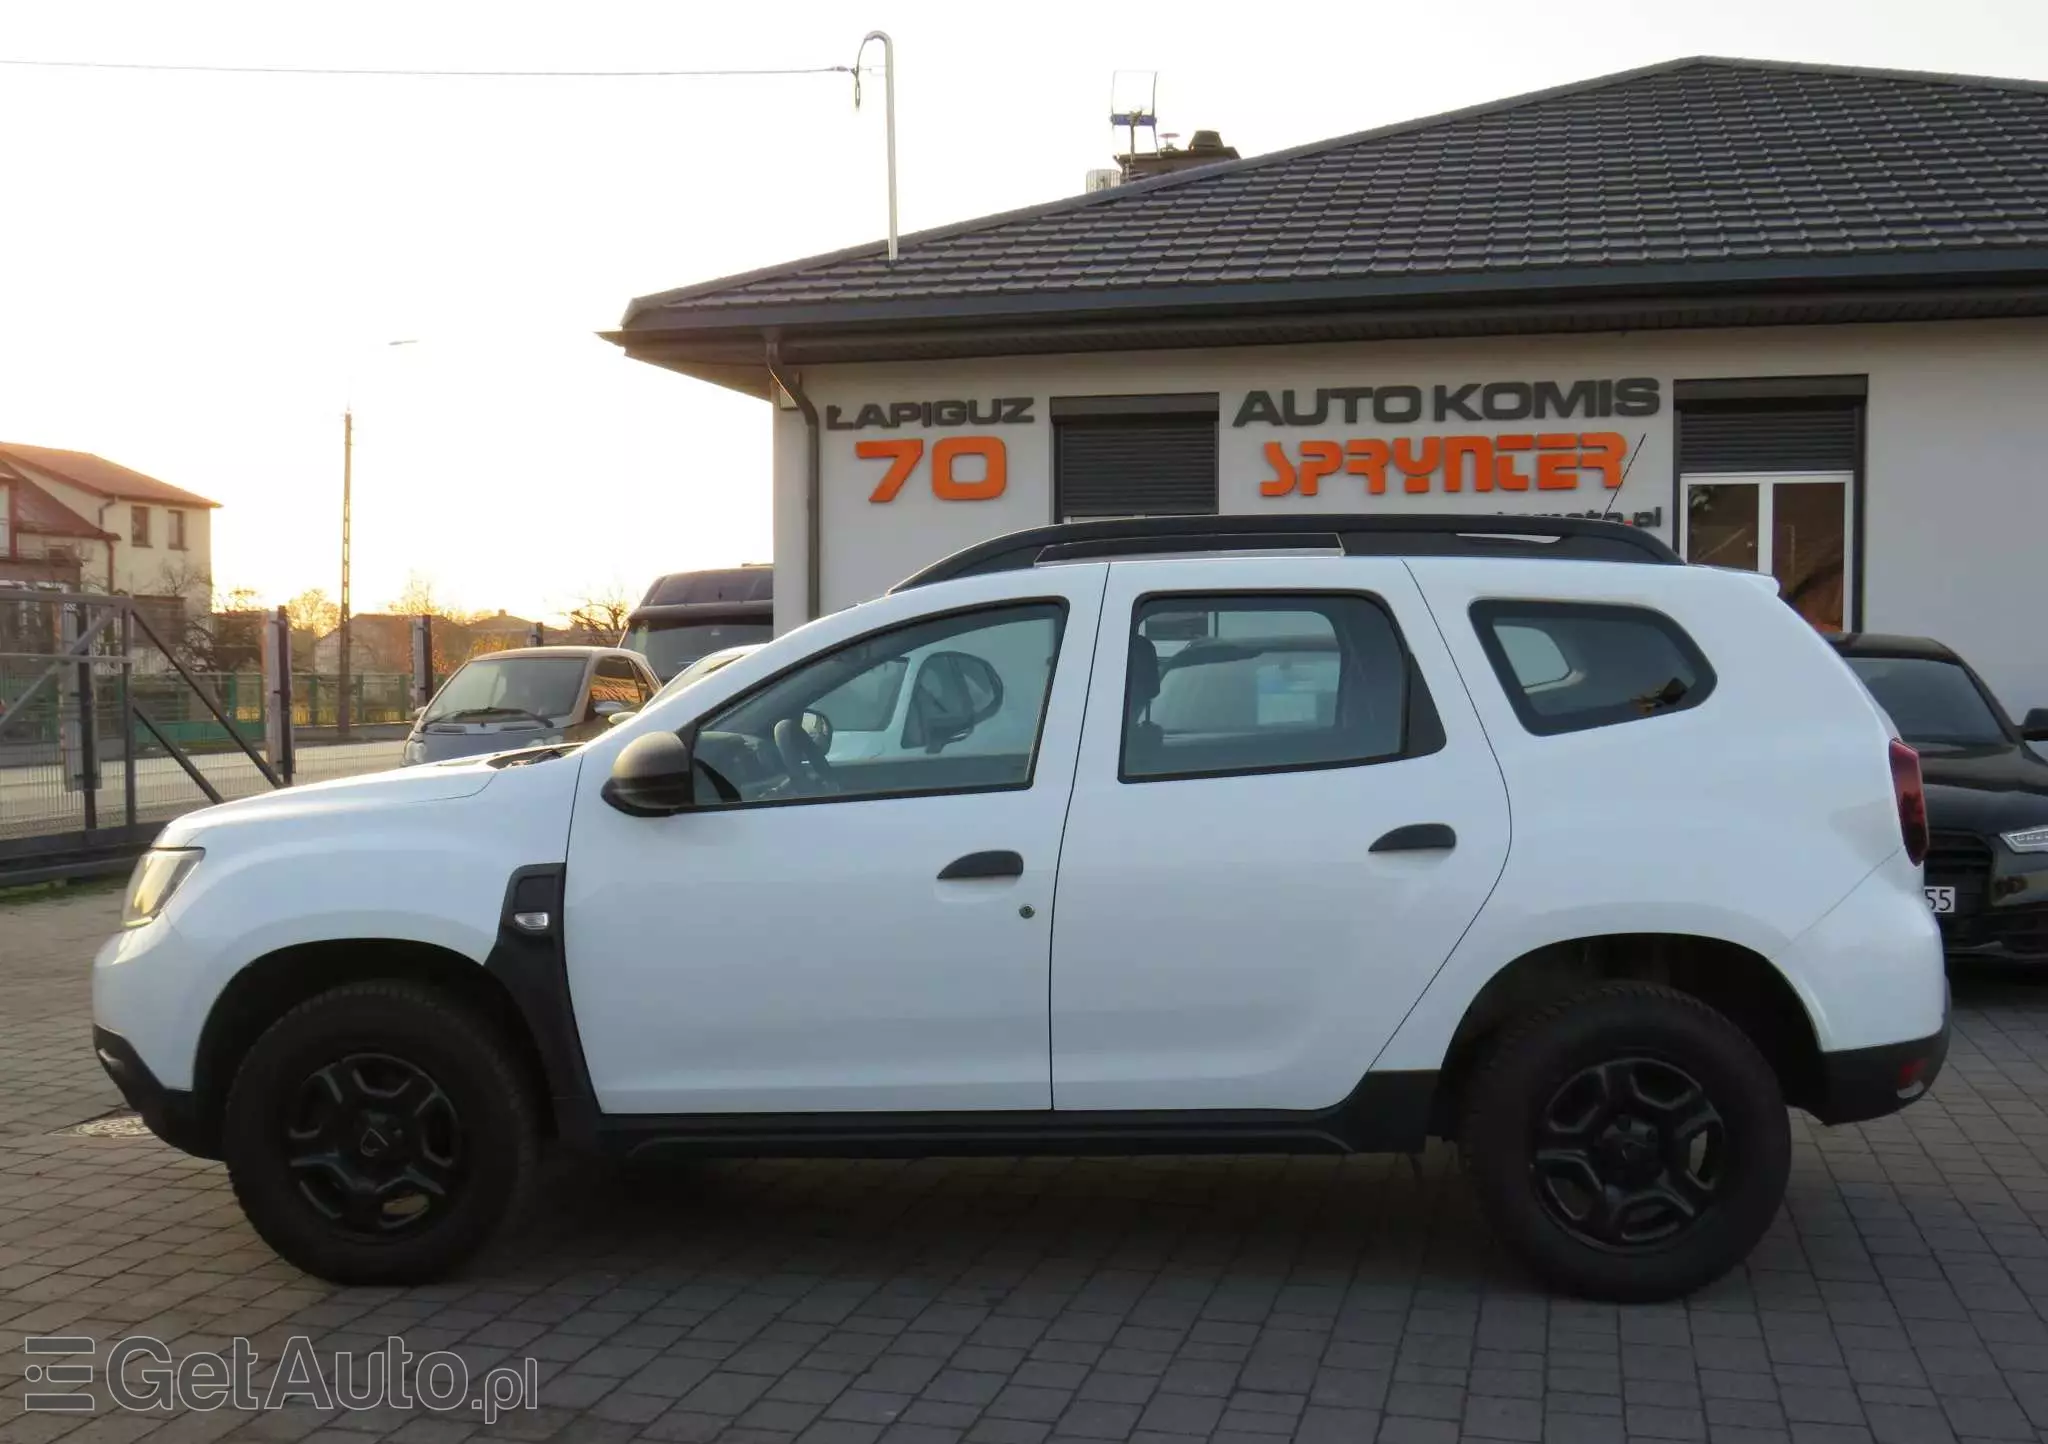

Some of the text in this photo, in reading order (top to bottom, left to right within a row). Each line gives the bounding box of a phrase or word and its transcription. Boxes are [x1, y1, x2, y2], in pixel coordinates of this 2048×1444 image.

[826, 397, 1035, 430] ŁAPIGUZ
[1232, 377, 1660, 428] AUTO KOMIS
[855, 436, 1007, 503] 70
[1260, 431, 1627, 497] SPRYNTER
